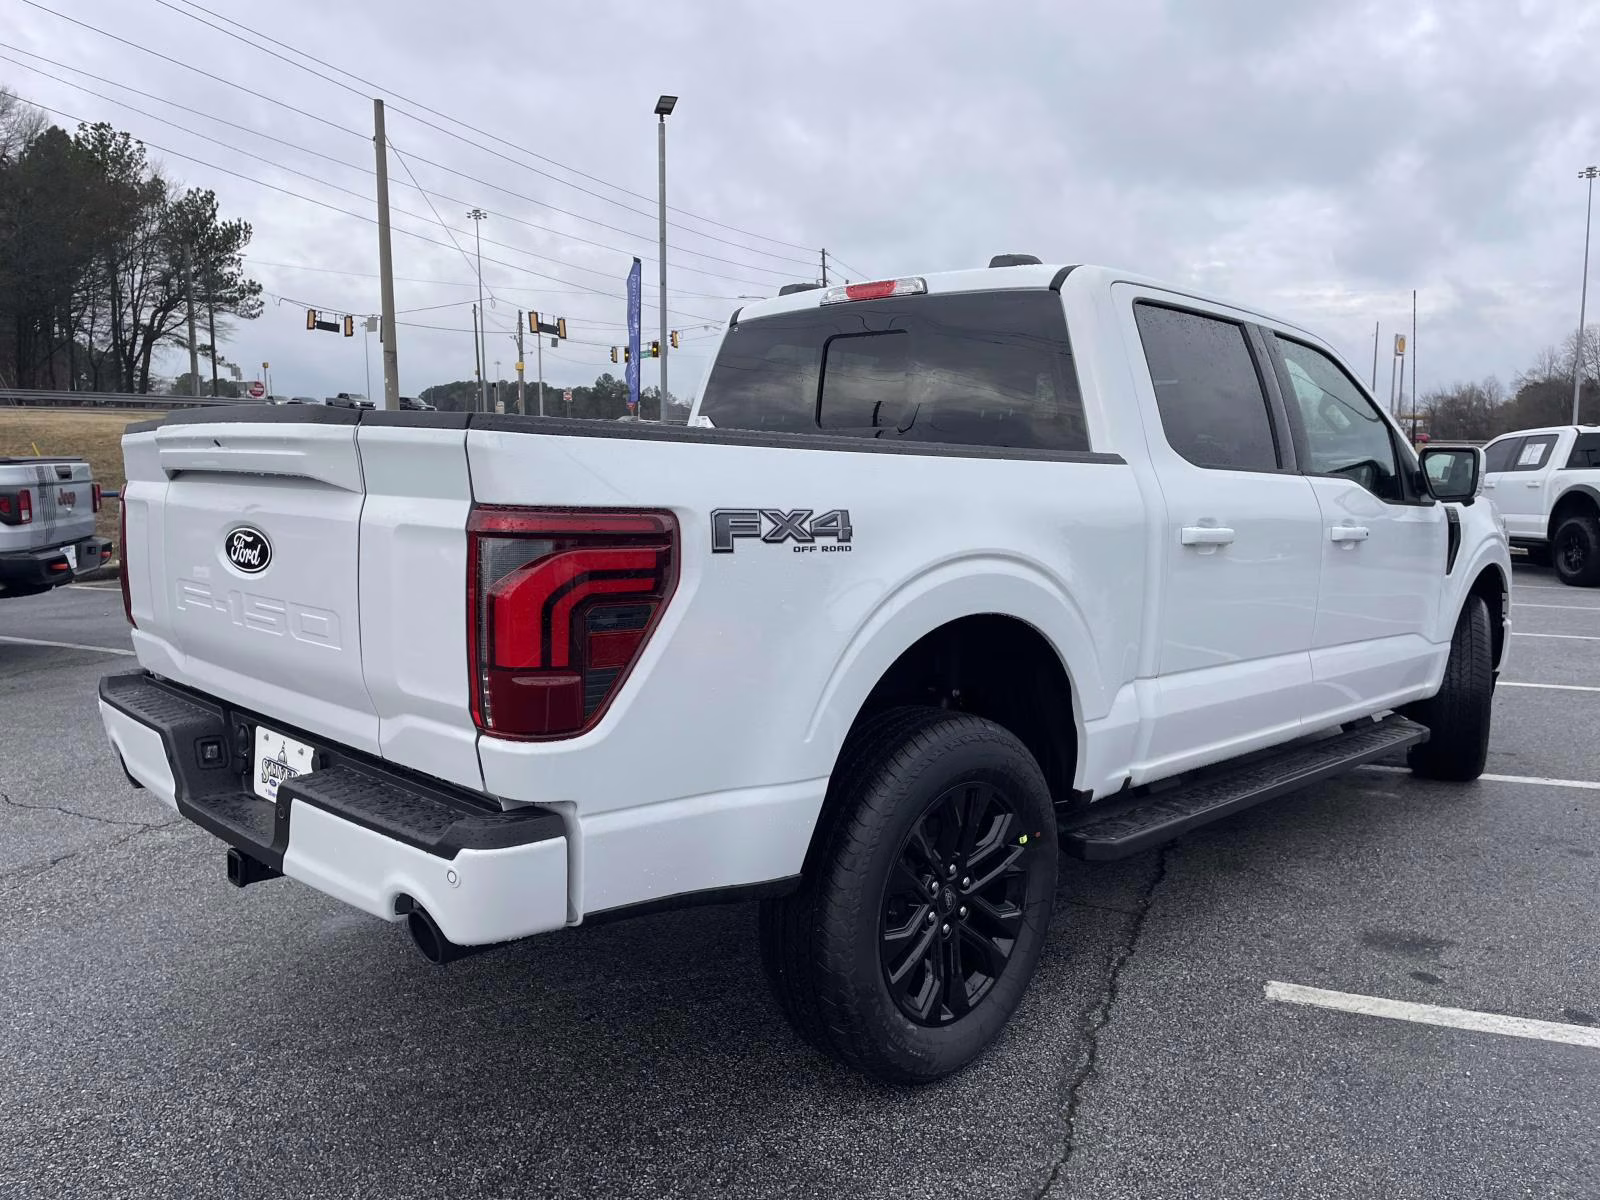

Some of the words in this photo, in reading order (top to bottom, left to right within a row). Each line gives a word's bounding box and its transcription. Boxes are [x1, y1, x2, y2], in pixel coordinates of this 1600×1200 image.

[231, 533, 261, 566] Ford
[711, 508, 853, 554] FX4
[793, 545, 818, 553] OFF
[821, 545, 852, 553] ROAD
[176, 578, 342, 651] F-150
